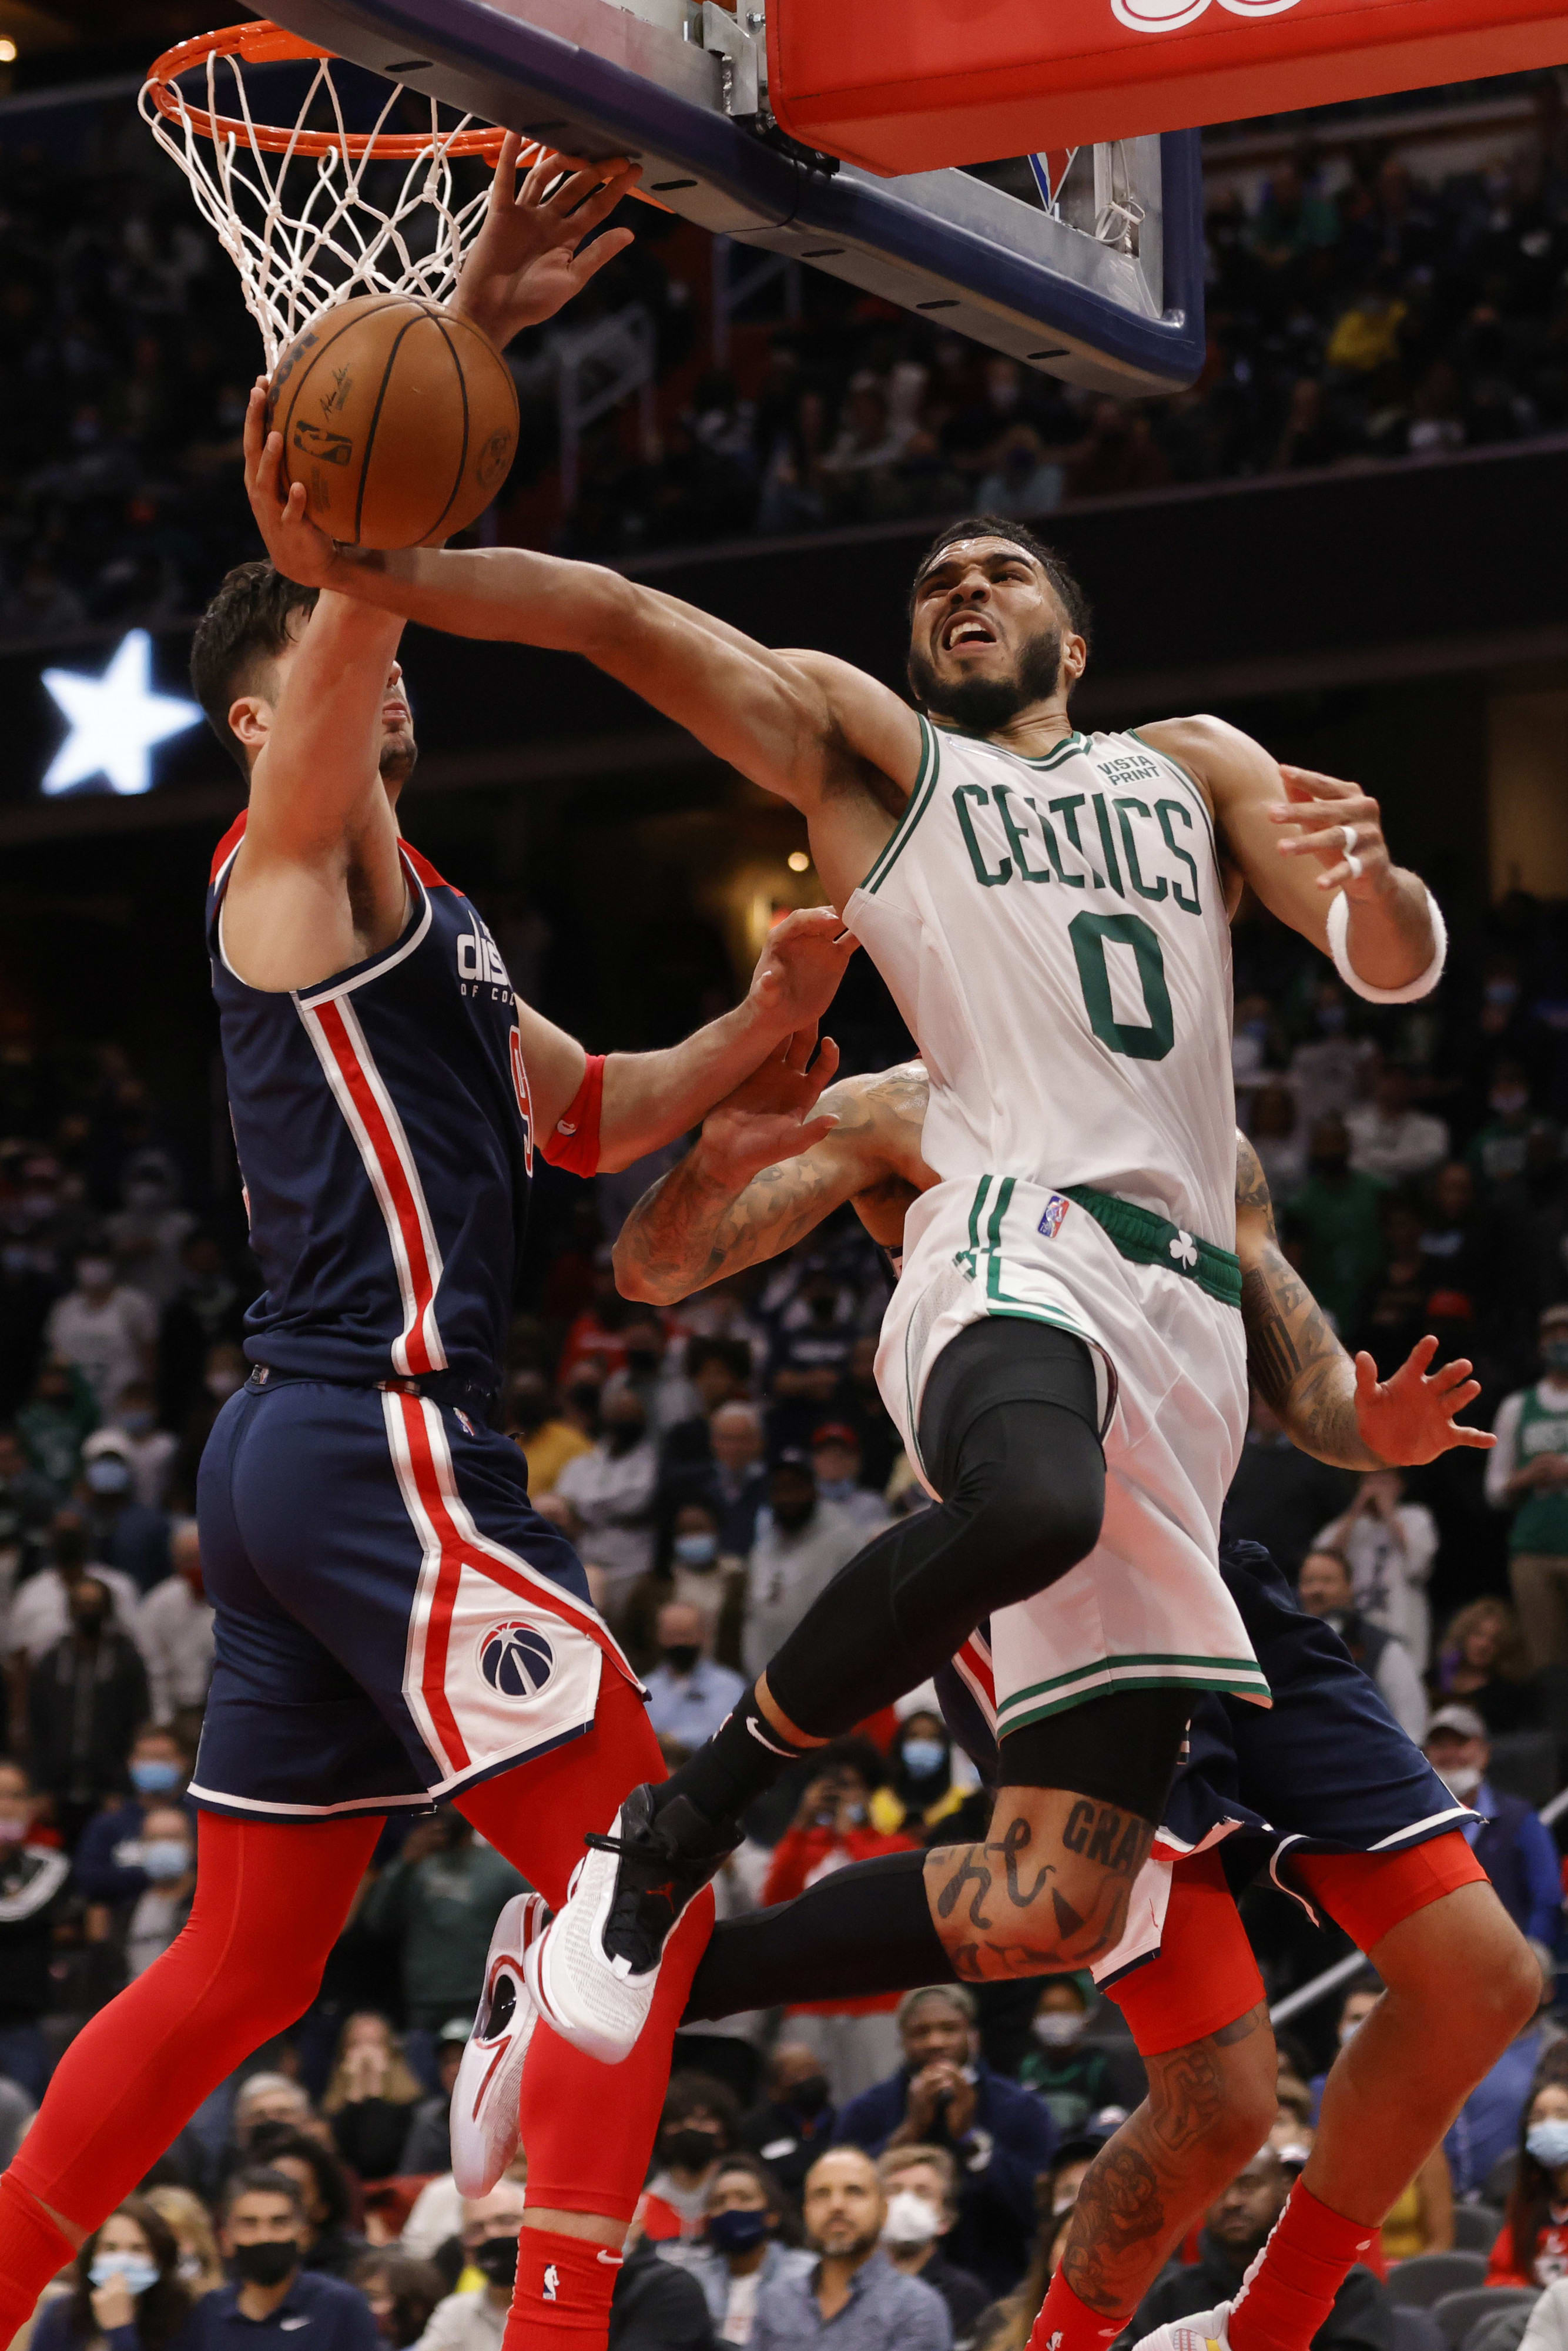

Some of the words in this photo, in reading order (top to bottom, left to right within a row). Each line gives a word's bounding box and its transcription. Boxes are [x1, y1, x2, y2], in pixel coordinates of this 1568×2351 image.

[1097, 755, 1154, 775] VISTA
[1108, 766, 1160, 786] PRINT
[951, 784, 1202, 916] CELTICS
[460, 983, 479, 998] OF
[1067, 910, 1175, 1061] 0
